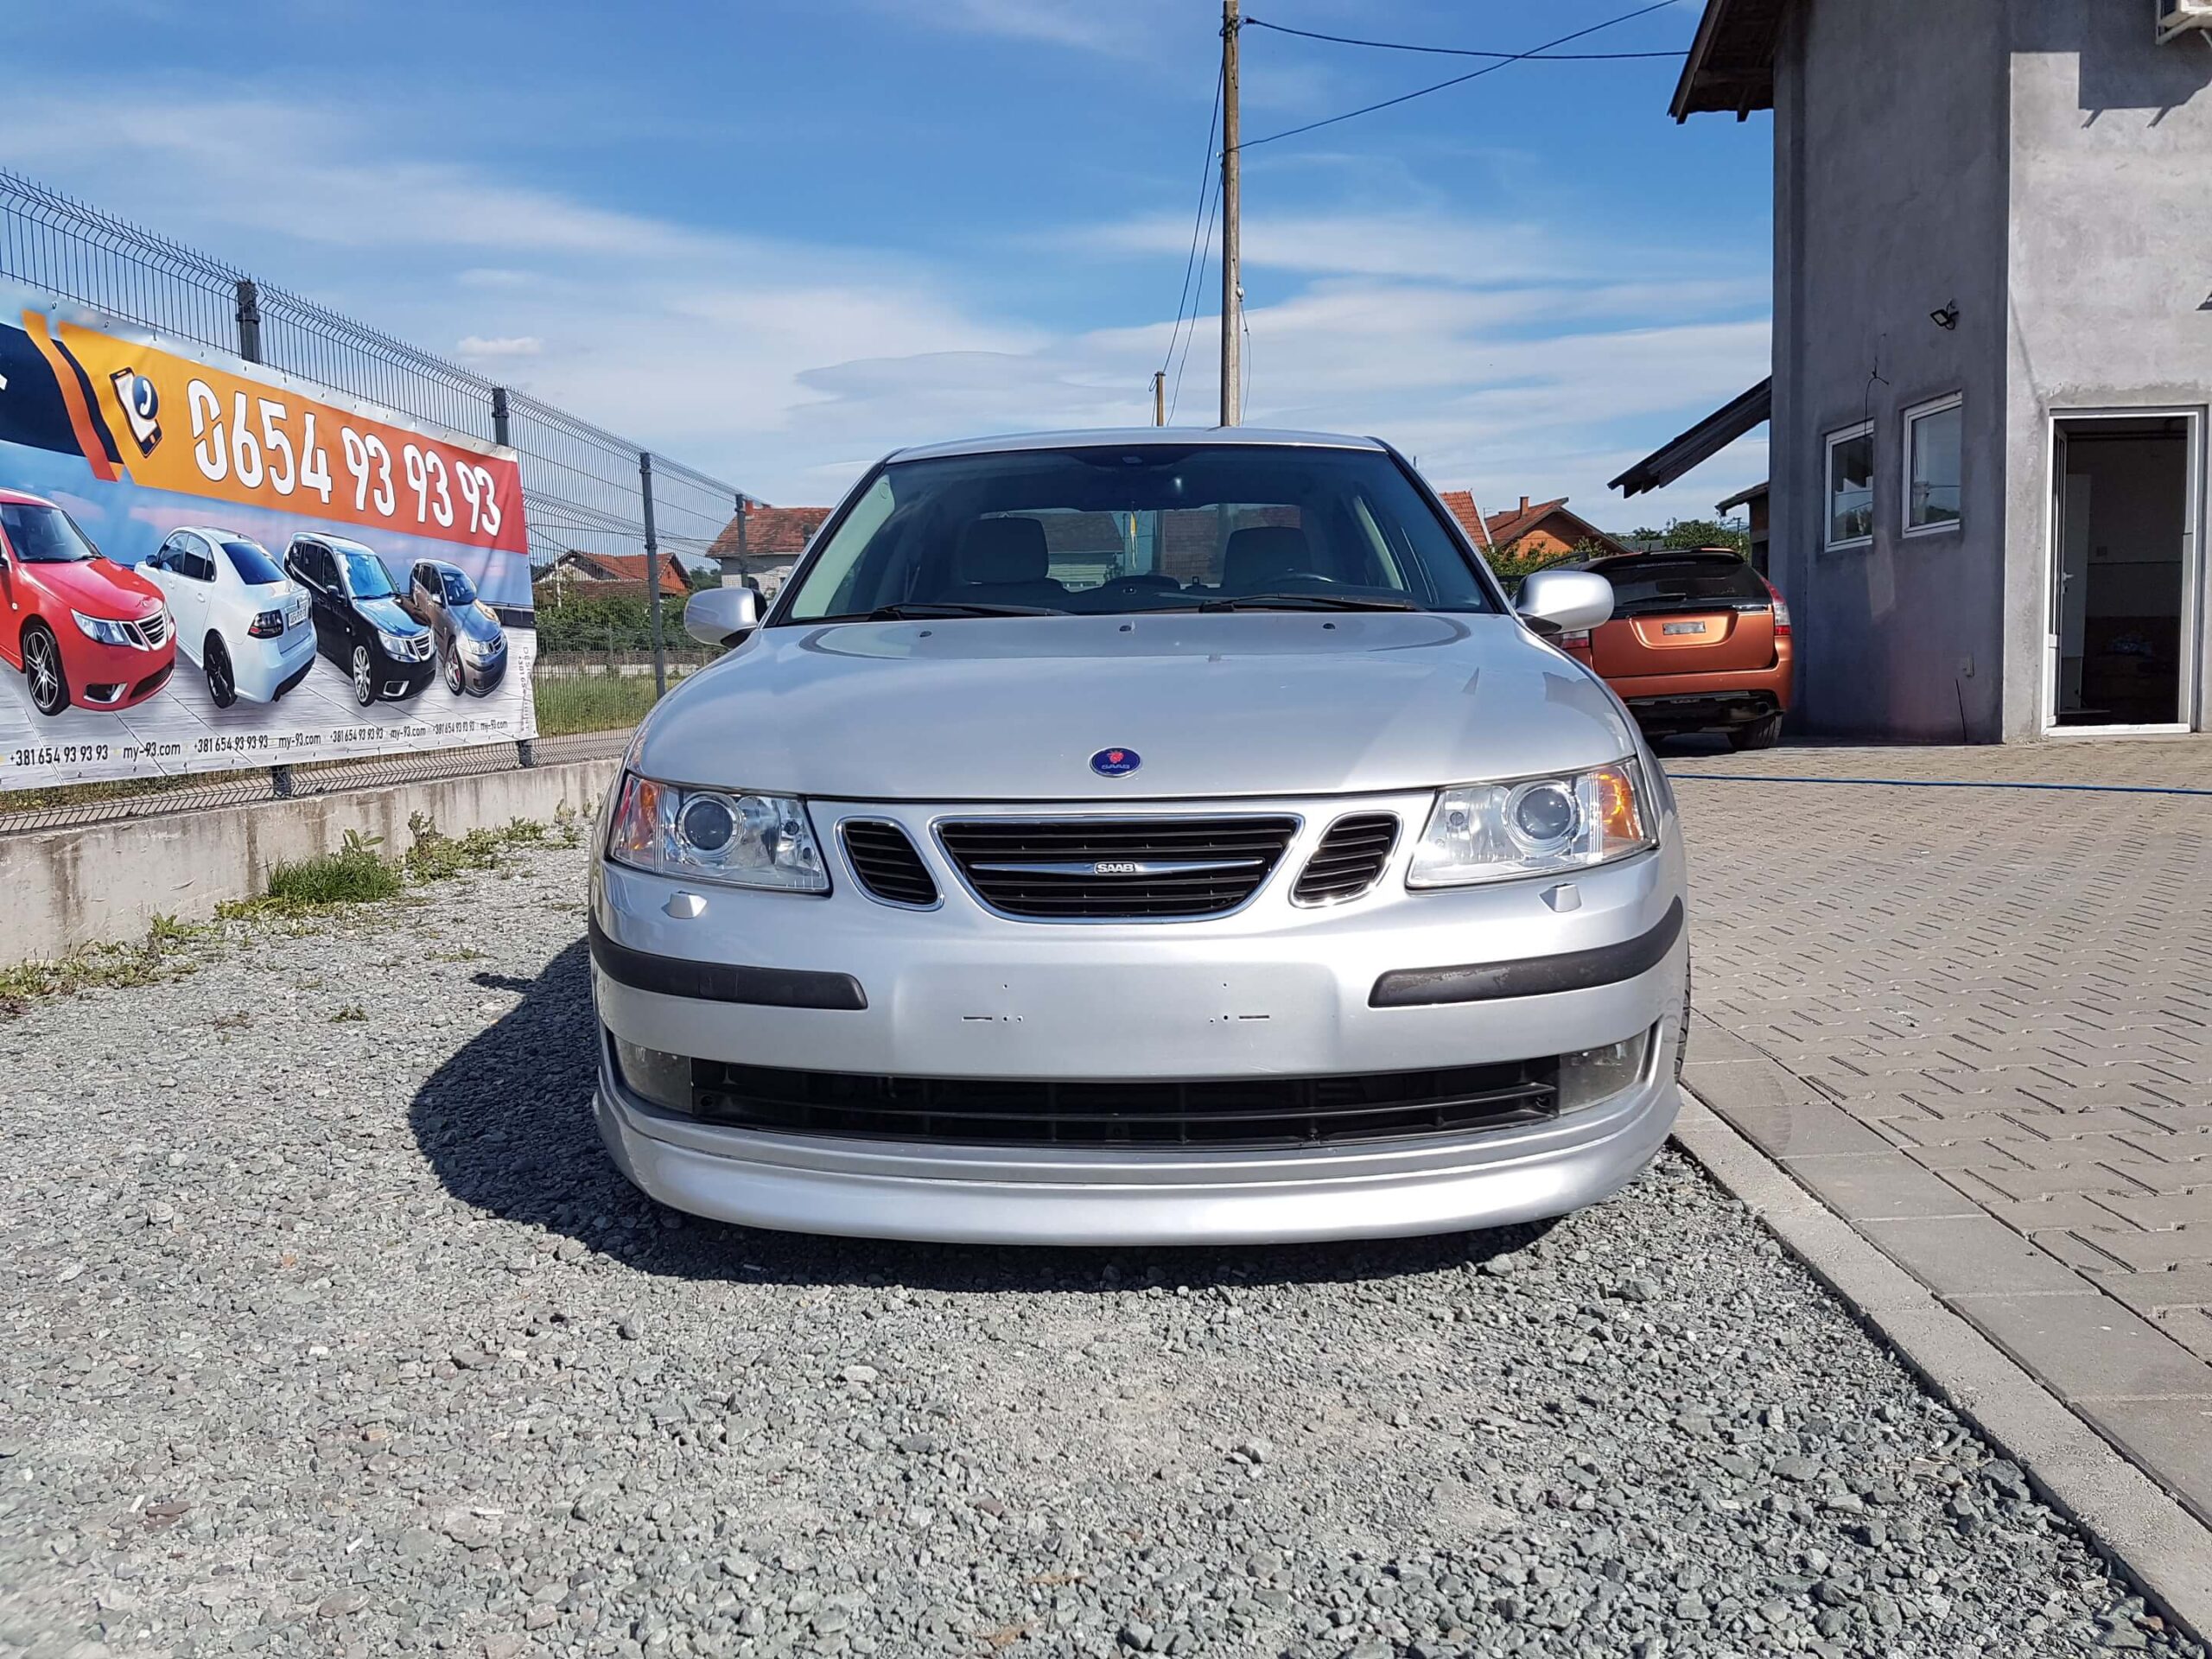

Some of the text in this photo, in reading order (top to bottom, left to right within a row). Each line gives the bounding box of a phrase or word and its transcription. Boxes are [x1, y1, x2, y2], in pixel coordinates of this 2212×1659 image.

[187, 378, 502, 537] 0654 93 93 93
[10, 748, 35, 766] +381
[38, 747, 60, 764] 654
[64, 747, 76, 763] 93
[80, 745, 92, 762] 93
[96, 744, 108, 760] 93
[123, 741, 181, 762] my-93.com
[194, 738, 213, 753] +381
[215, 737, 232, 751] 654
[234, 736, 245, 750] 93
[246, 735, 257, 749] 93
[258, 734, 268, 748] 93
[278, 733, 321, 750] my-93.com
[330, 730, 344, 742] +381
[345, 729, 357, 741] 654
[359, 728, 366, 741] 93
[367, 728, 375, 740] 93
[376, 728, 384, 740] 93
[390, 726, 427, 741] my-93.com
[1097, 863, 1135, 873] SAAB
